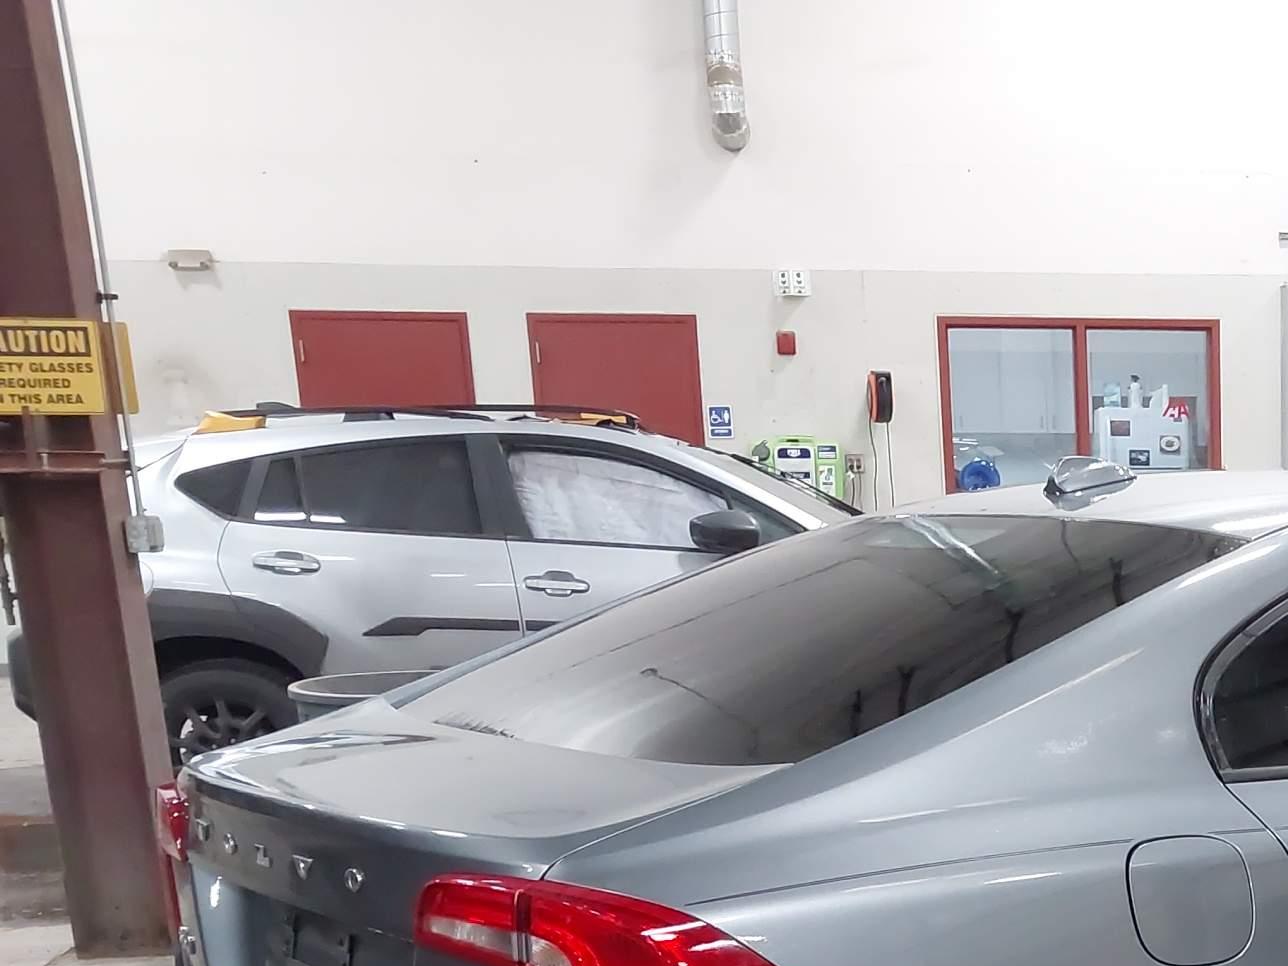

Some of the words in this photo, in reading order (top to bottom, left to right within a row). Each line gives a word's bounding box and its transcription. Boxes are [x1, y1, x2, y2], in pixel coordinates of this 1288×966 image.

[29, 362, 94, 374] GLASSES
[0, 378, 71, 389] REQUIRED
[8, 393, 42, 404] THIS
[46, 393, 84, 405] AREA
[195, 818, 366, 893] VOLVO
